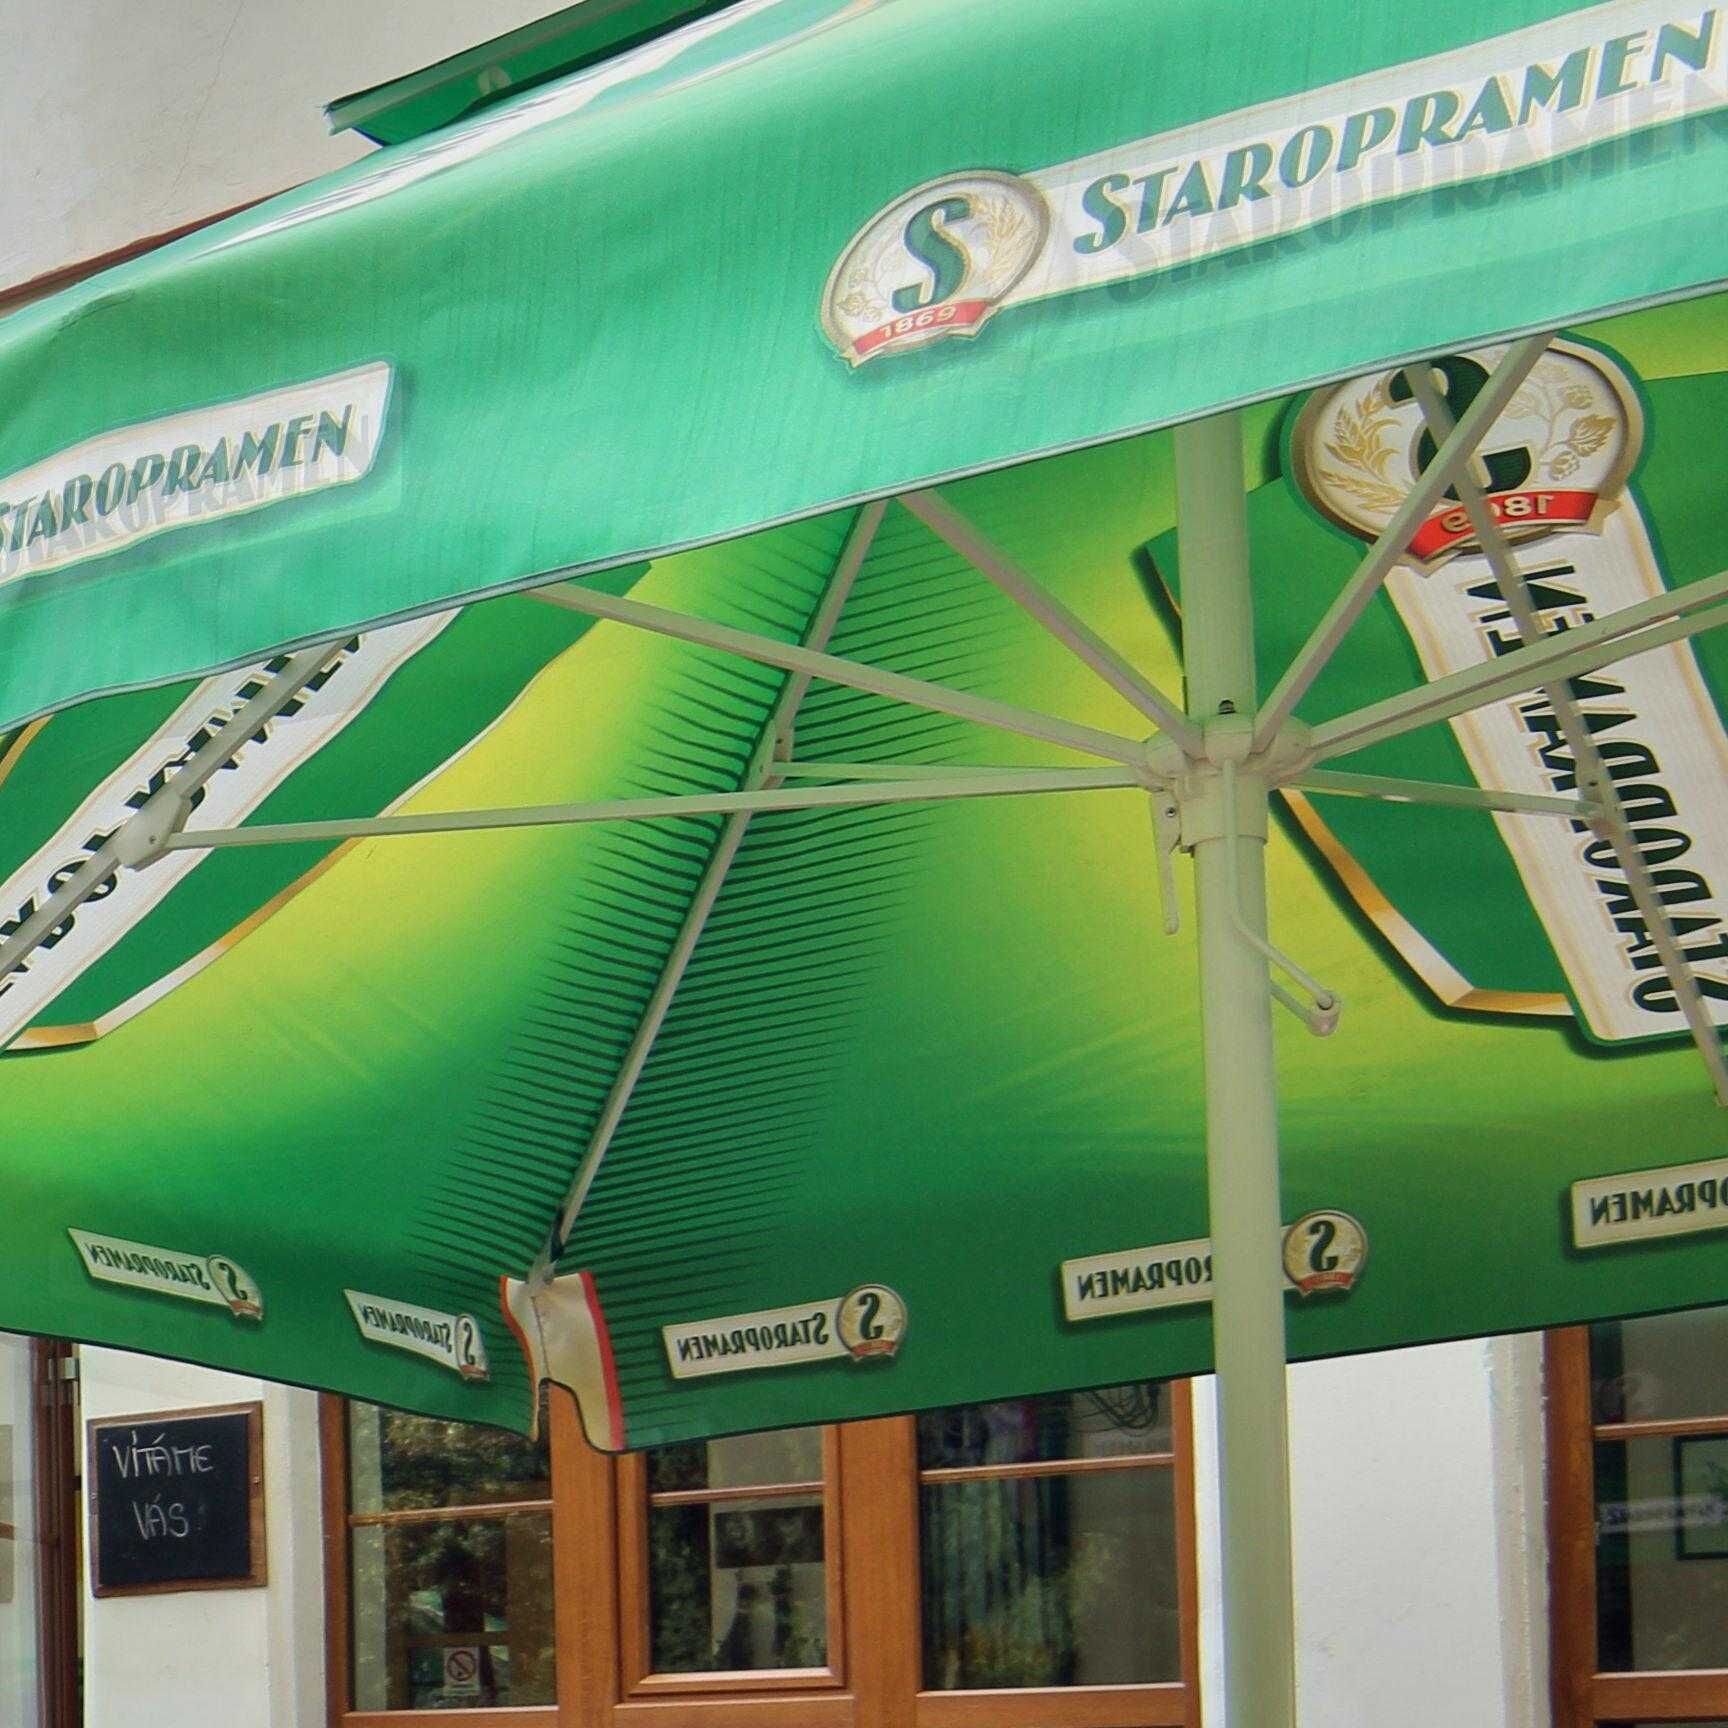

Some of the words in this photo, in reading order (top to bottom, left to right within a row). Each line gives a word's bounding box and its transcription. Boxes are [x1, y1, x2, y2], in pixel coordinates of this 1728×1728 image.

[892, 195, 971, 315] S
[1072, 9, 1721, 255] STAROPRAMEN
[880, 303, 958, 341] 1869
[132, 1493, 190, 1540] VÁS
